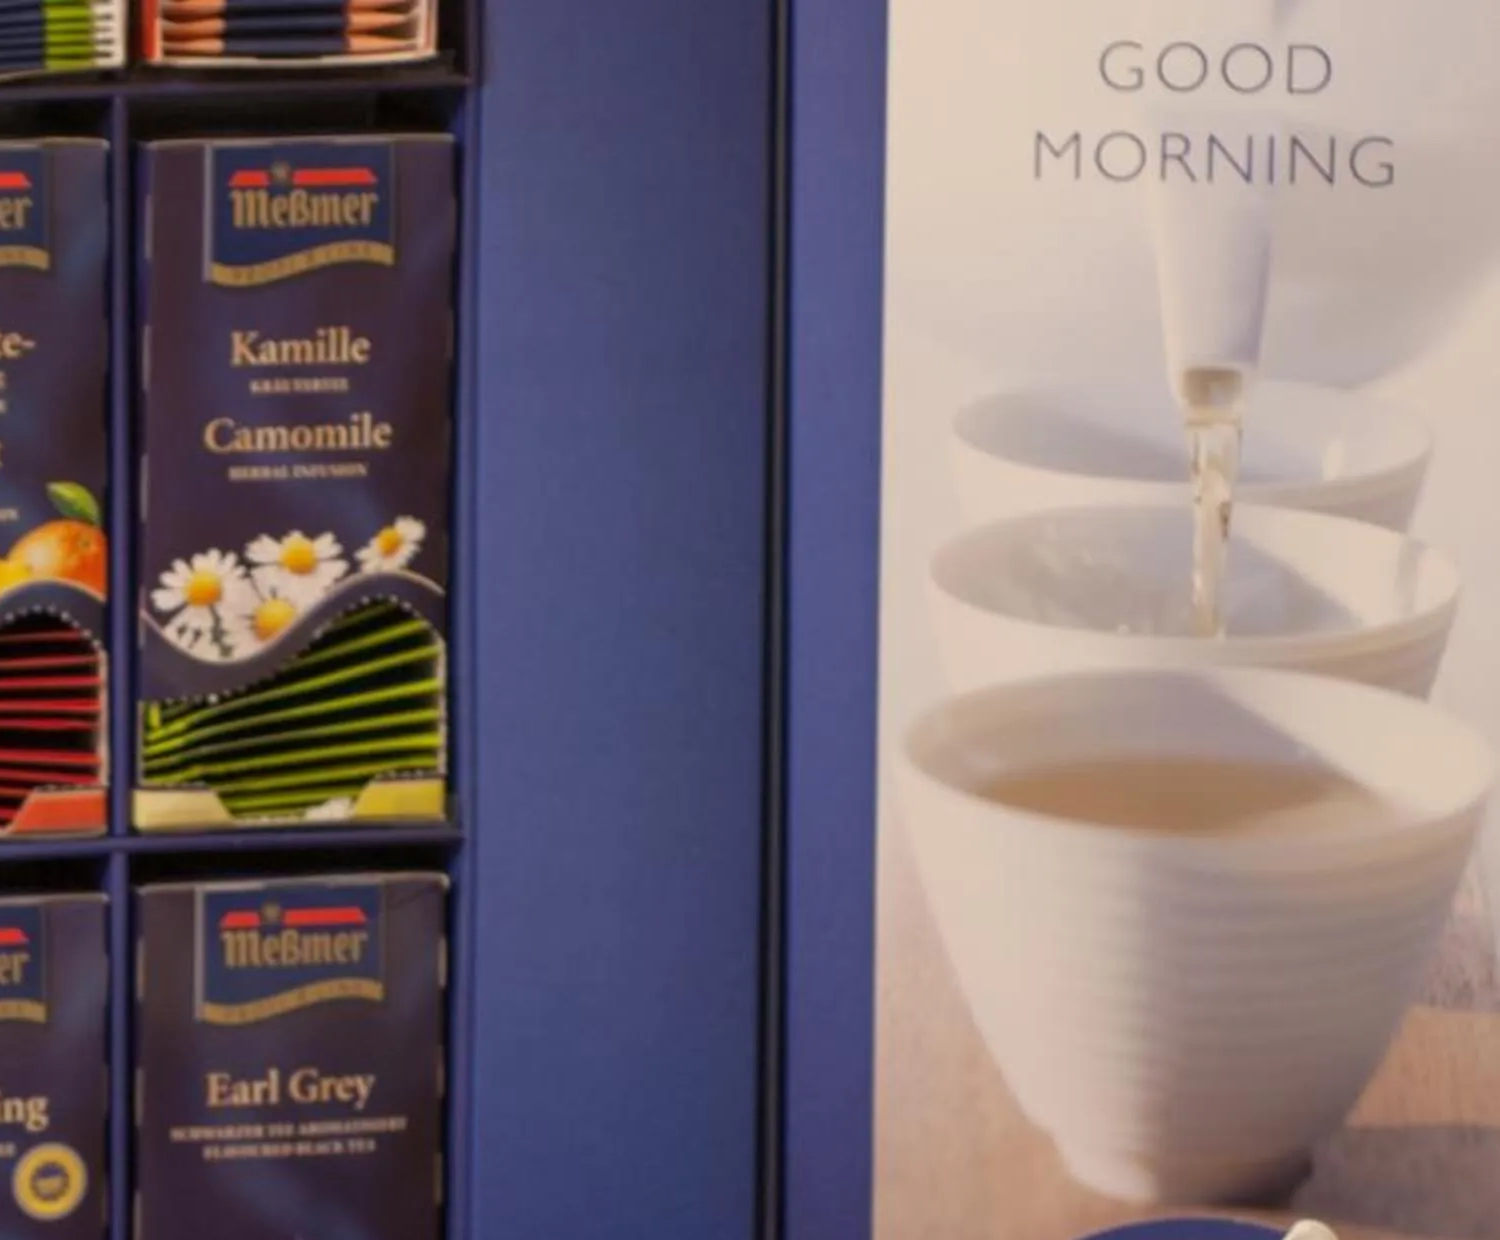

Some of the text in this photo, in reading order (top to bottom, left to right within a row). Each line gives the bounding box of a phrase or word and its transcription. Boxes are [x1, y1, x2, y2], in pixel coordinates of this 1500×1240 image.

[1098, 39, 1332, 95] GOOD
[1033, 130, 1396, 188] MORNING
[228, 189, 379, 228] Meßmer
[229, 325, 372, 367] Kamille
[204, 411, 393, 454] Camomile
[220, 928, 369, 969] Meßmer
[206, 1067, 377, 1111] Earl Grey
